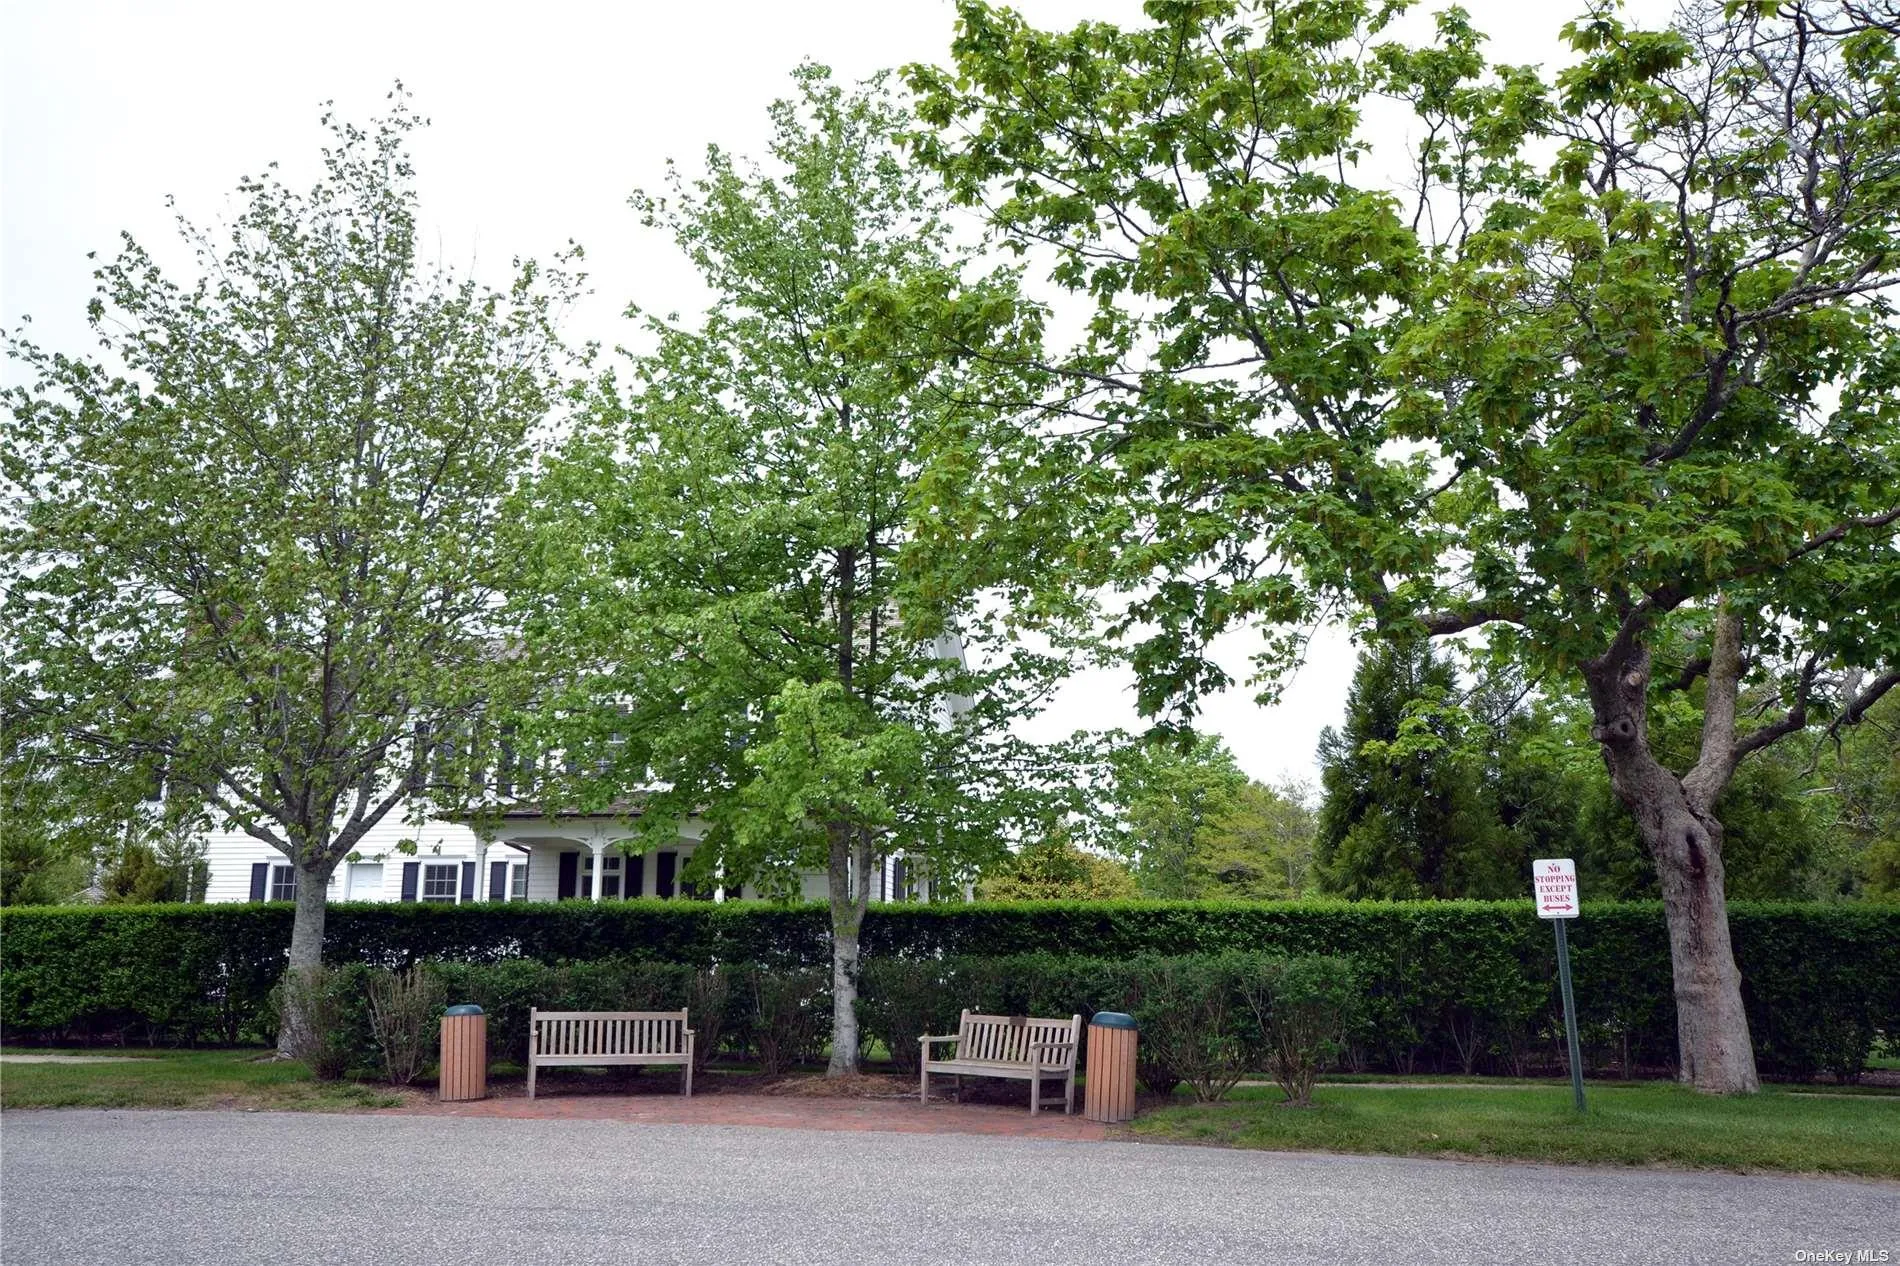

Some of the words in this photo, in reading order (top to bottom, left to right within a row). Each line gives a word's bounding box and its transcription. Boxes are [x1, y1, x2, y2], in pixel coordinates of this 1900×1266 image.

[1547, 865, 1561, 873] NO
[1535, 874, 1575, 883] STOPPING
[1540, 885, 1572, 893] EXCEPT
[1543, 894, 1570, 902] BUSES
